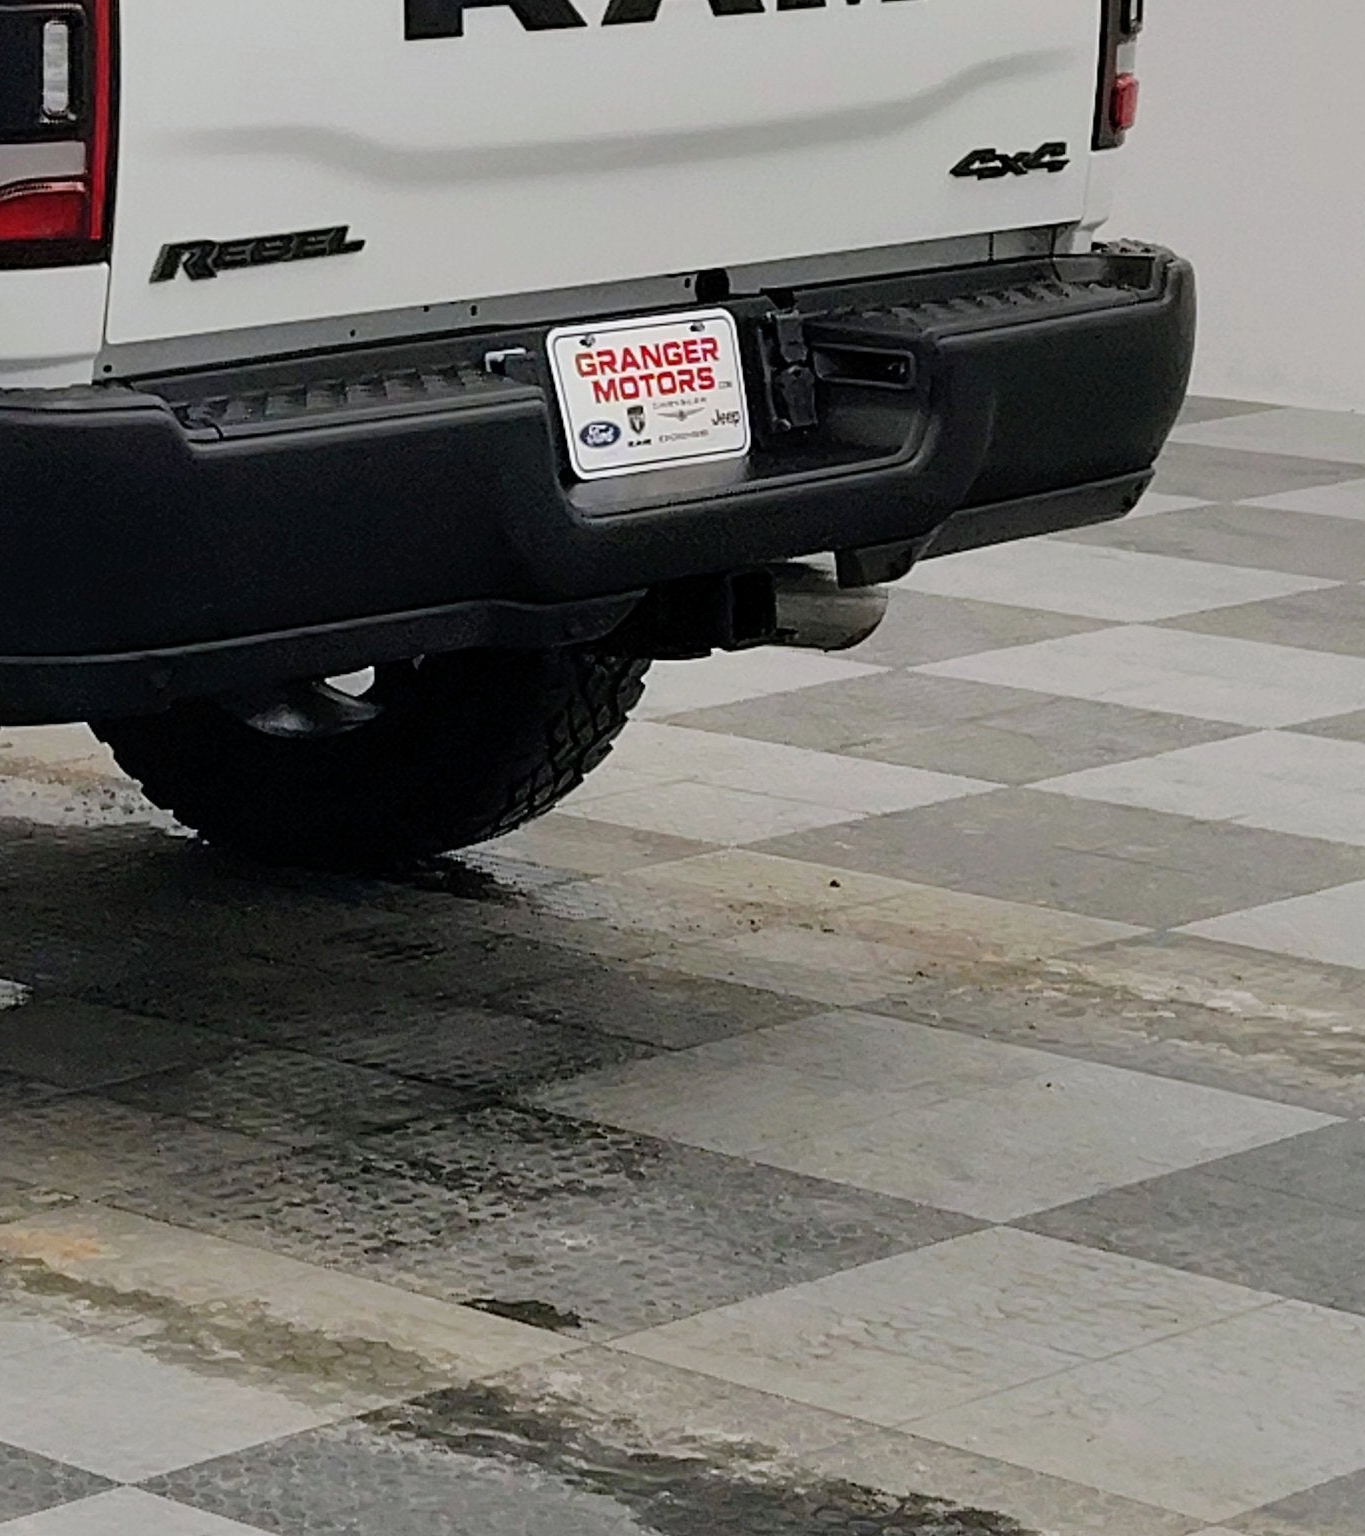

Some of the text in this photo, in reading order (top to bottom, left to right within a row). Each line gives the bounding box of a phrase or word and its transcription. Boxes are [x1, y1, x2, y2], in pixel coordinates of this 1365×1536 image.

[149, 225, 366, 284] REBEL
[575, 337, 719, 377] GRANGER
[591, 367, 715, 404] MOTORS
[711, 409, 741, 427] Jeep
